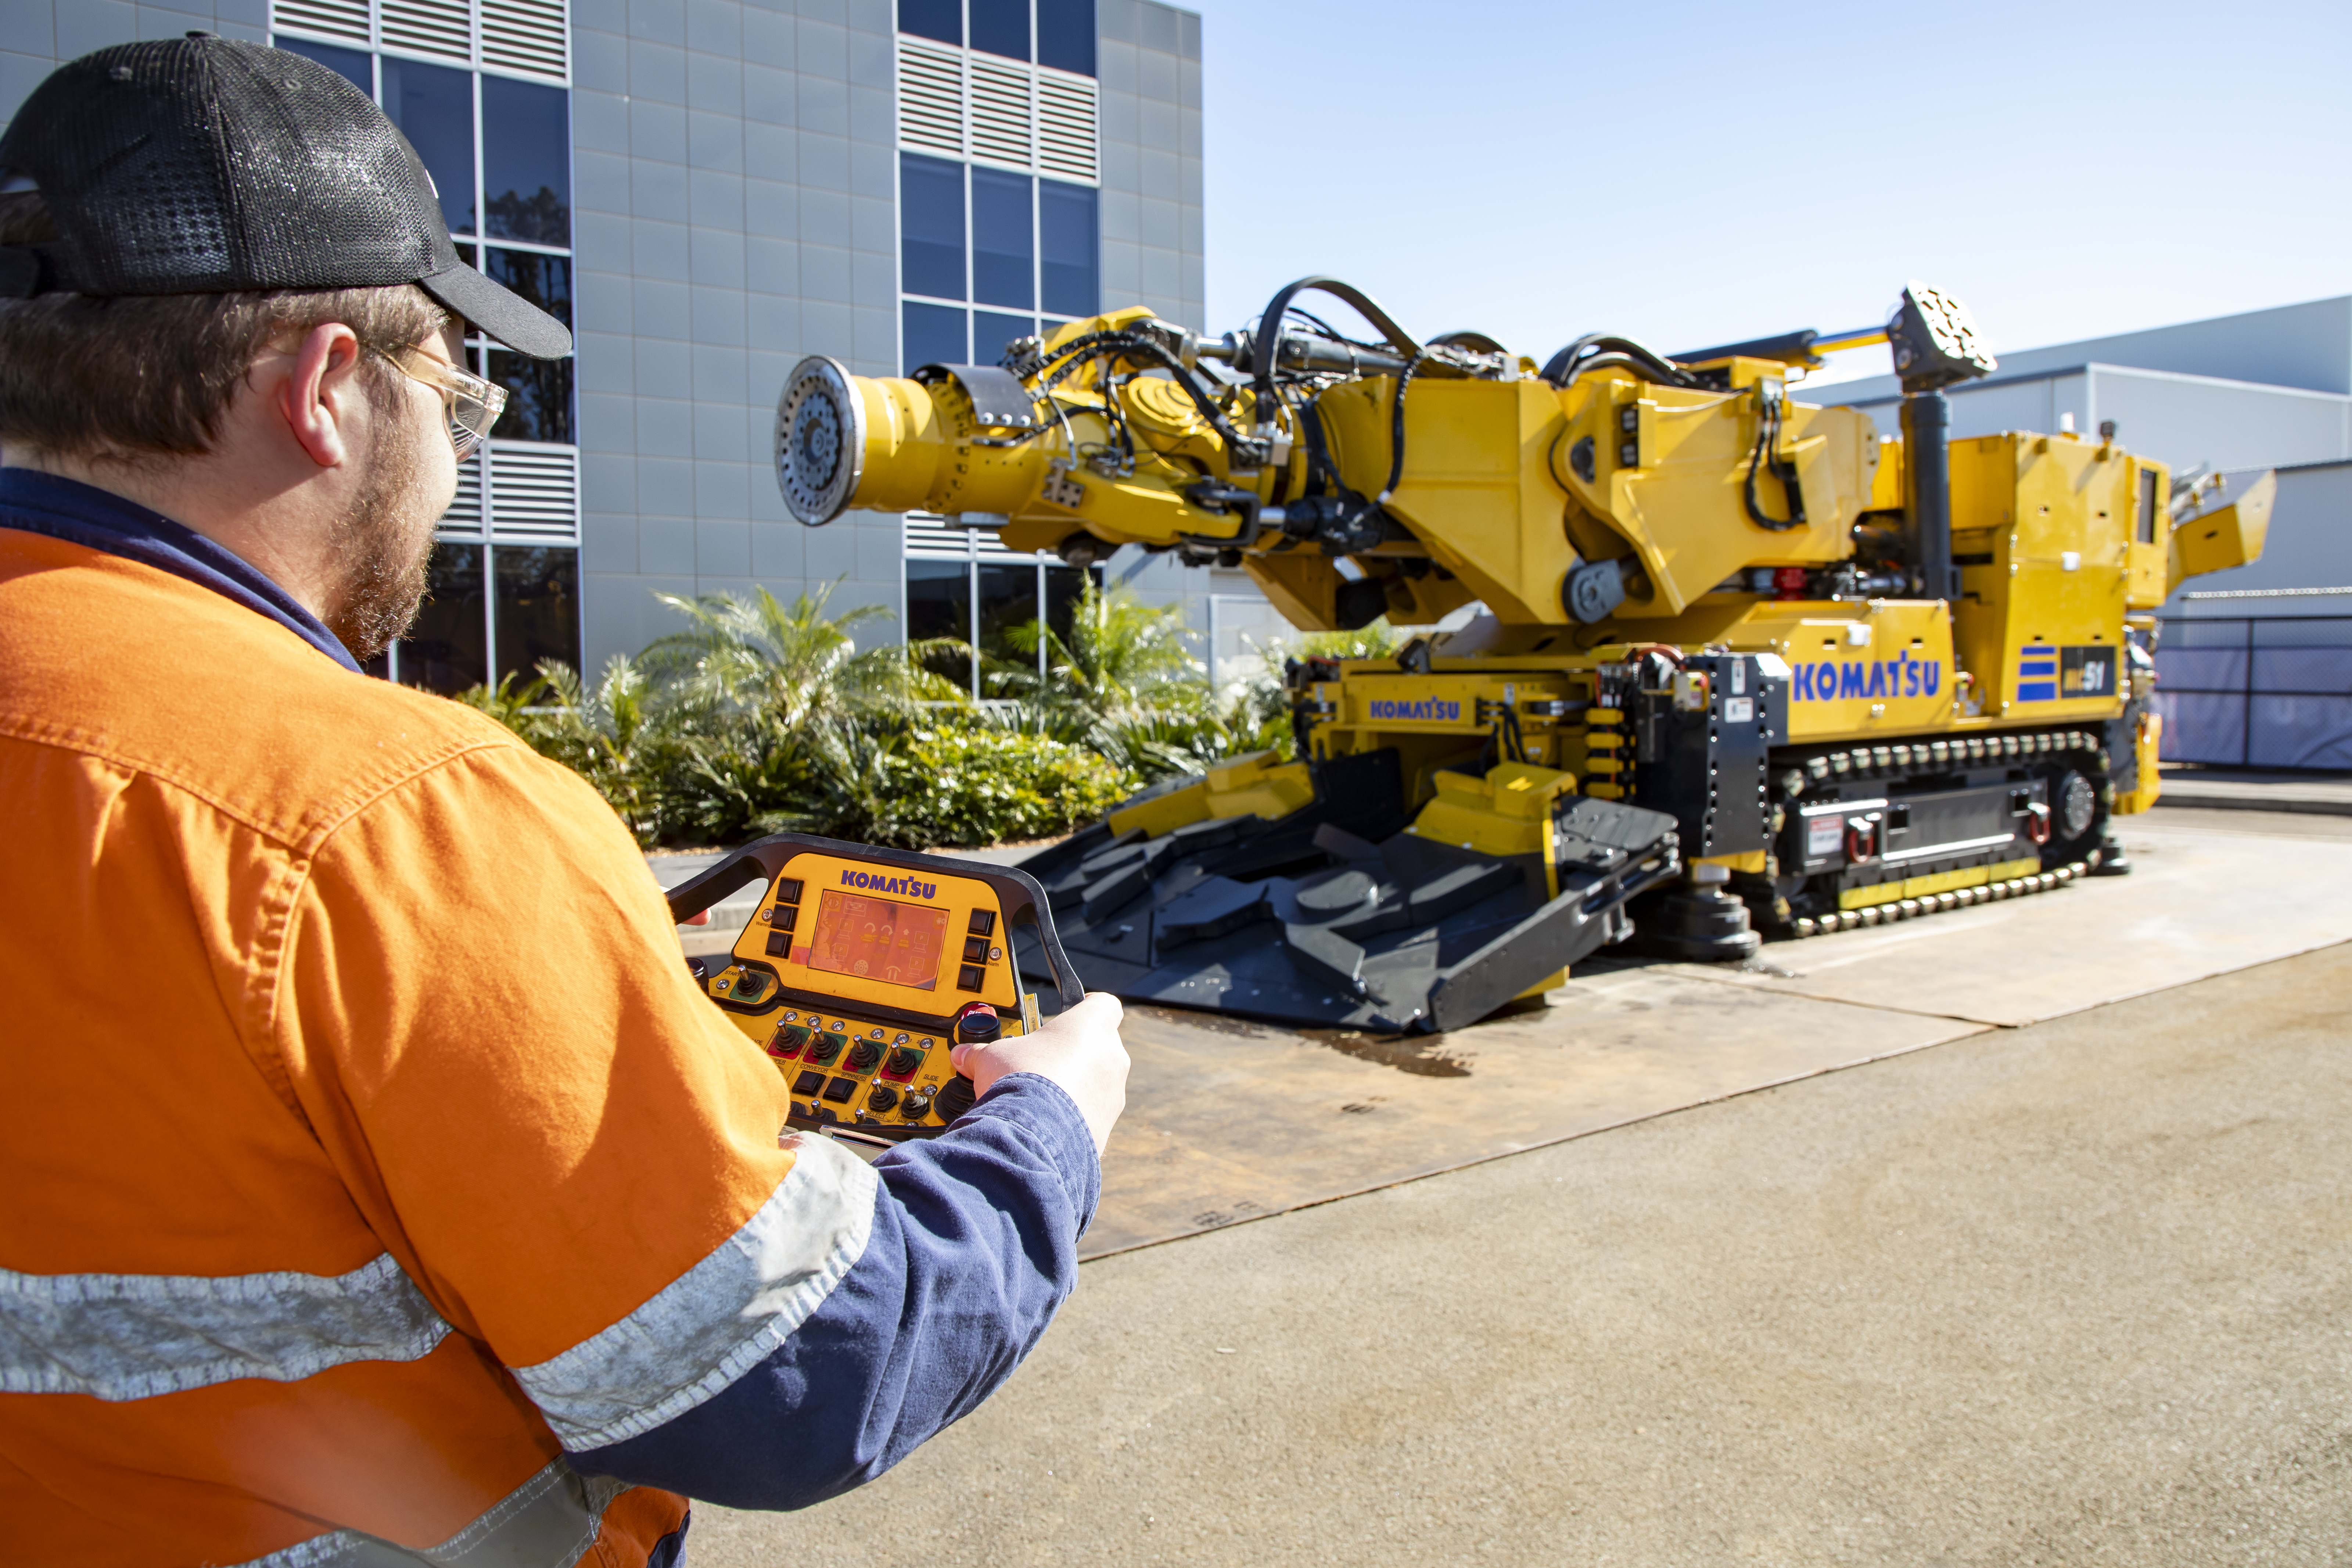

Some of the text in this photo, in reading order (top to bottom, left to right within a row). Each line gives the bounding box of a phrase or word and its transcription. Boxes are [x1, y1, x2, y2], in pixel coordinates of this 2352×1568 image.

[1793, 649, 1939, 701] KOMATSU
[1370, 695, 1460, 721] KOMATSU
[841, 869, 936, 899] KOMATSU
[800, 1063, 829, 1073] CONVEYOR
[841, 1072, 867, 1081] SPINNERS
[865, 1110, 886, 1119] SELECT
